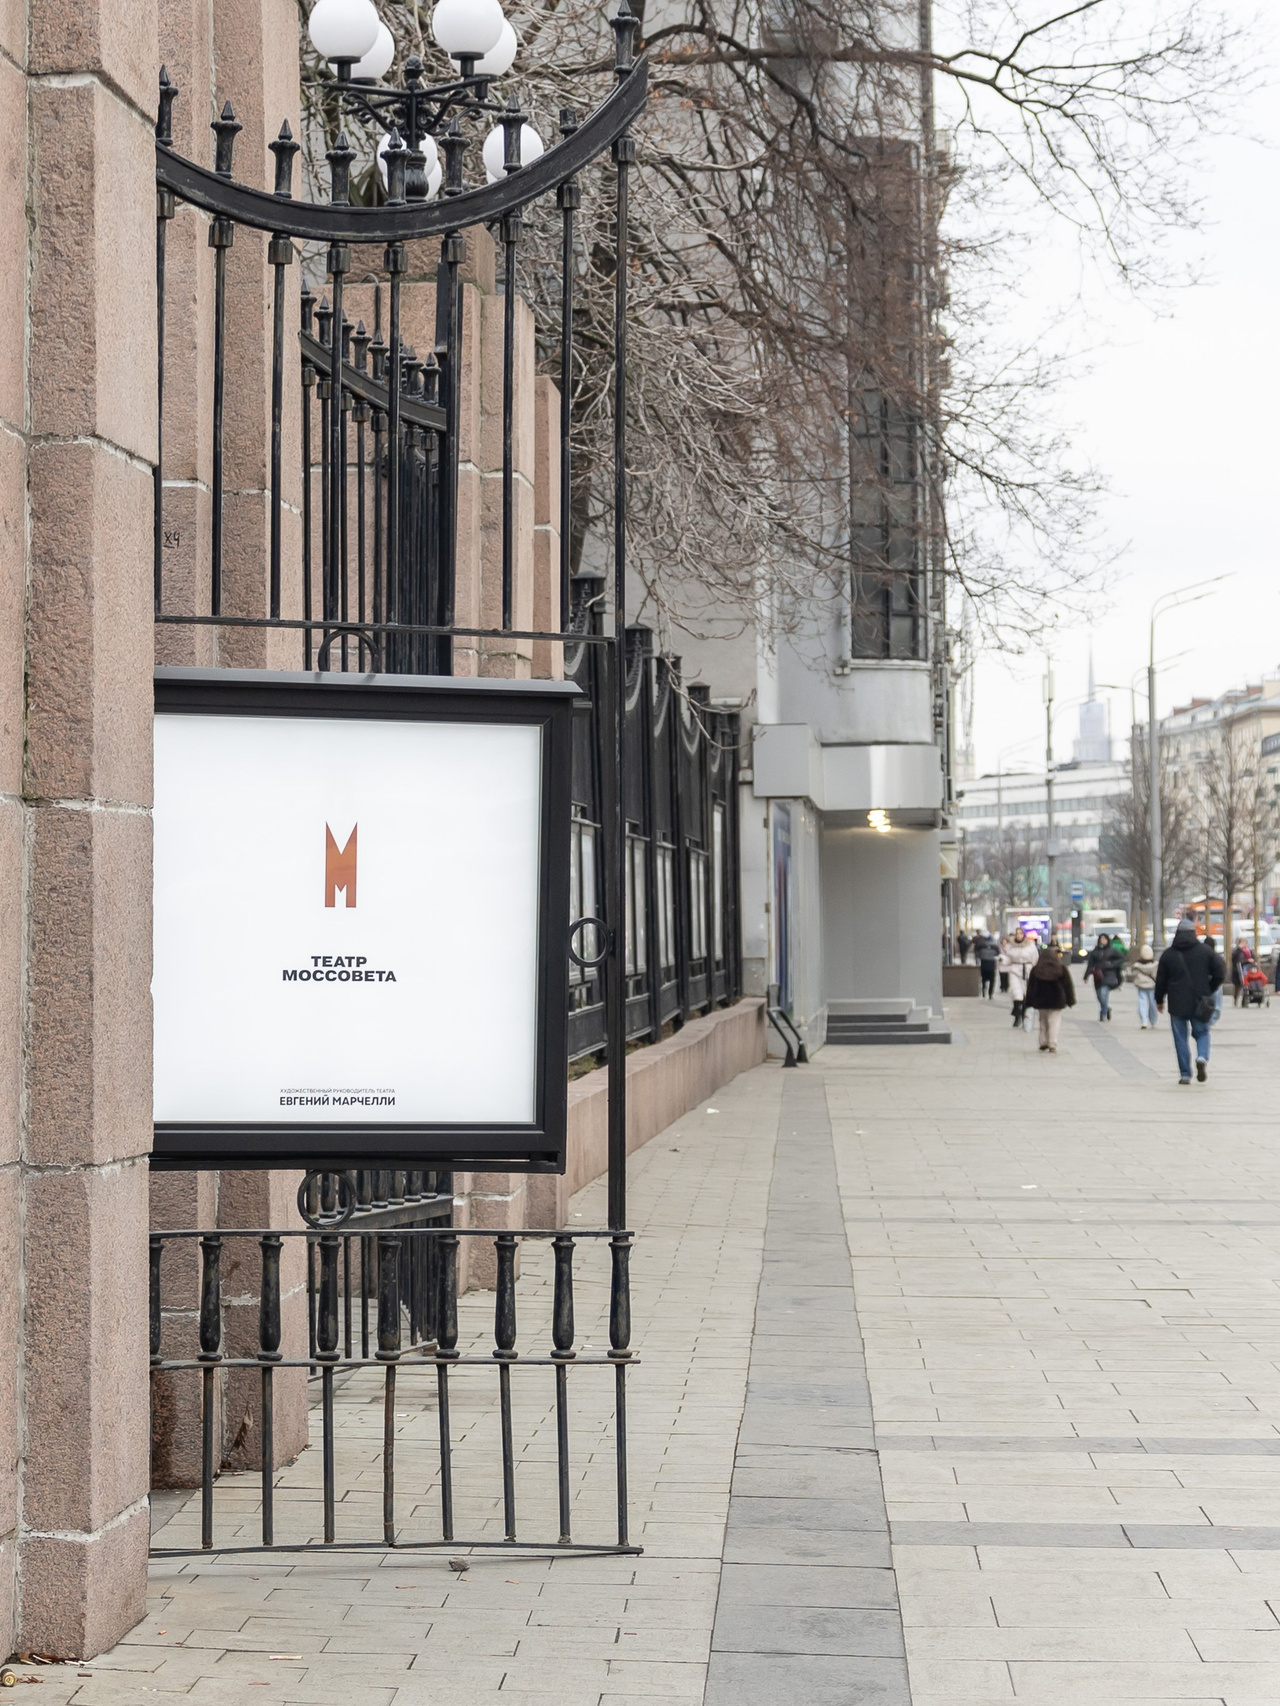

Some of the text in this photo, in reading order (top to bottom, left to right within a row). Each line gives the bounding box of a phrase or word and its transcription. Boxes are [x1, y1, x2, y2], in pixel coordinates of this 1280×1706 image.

[310, 955, 368, 968] ТЕАТР
[281, 969, 397, 982] МОССОВЕТА
[279, 1094, 396, 1106] ЕВГЕНИЙ МАРЧЕЛЛИ
